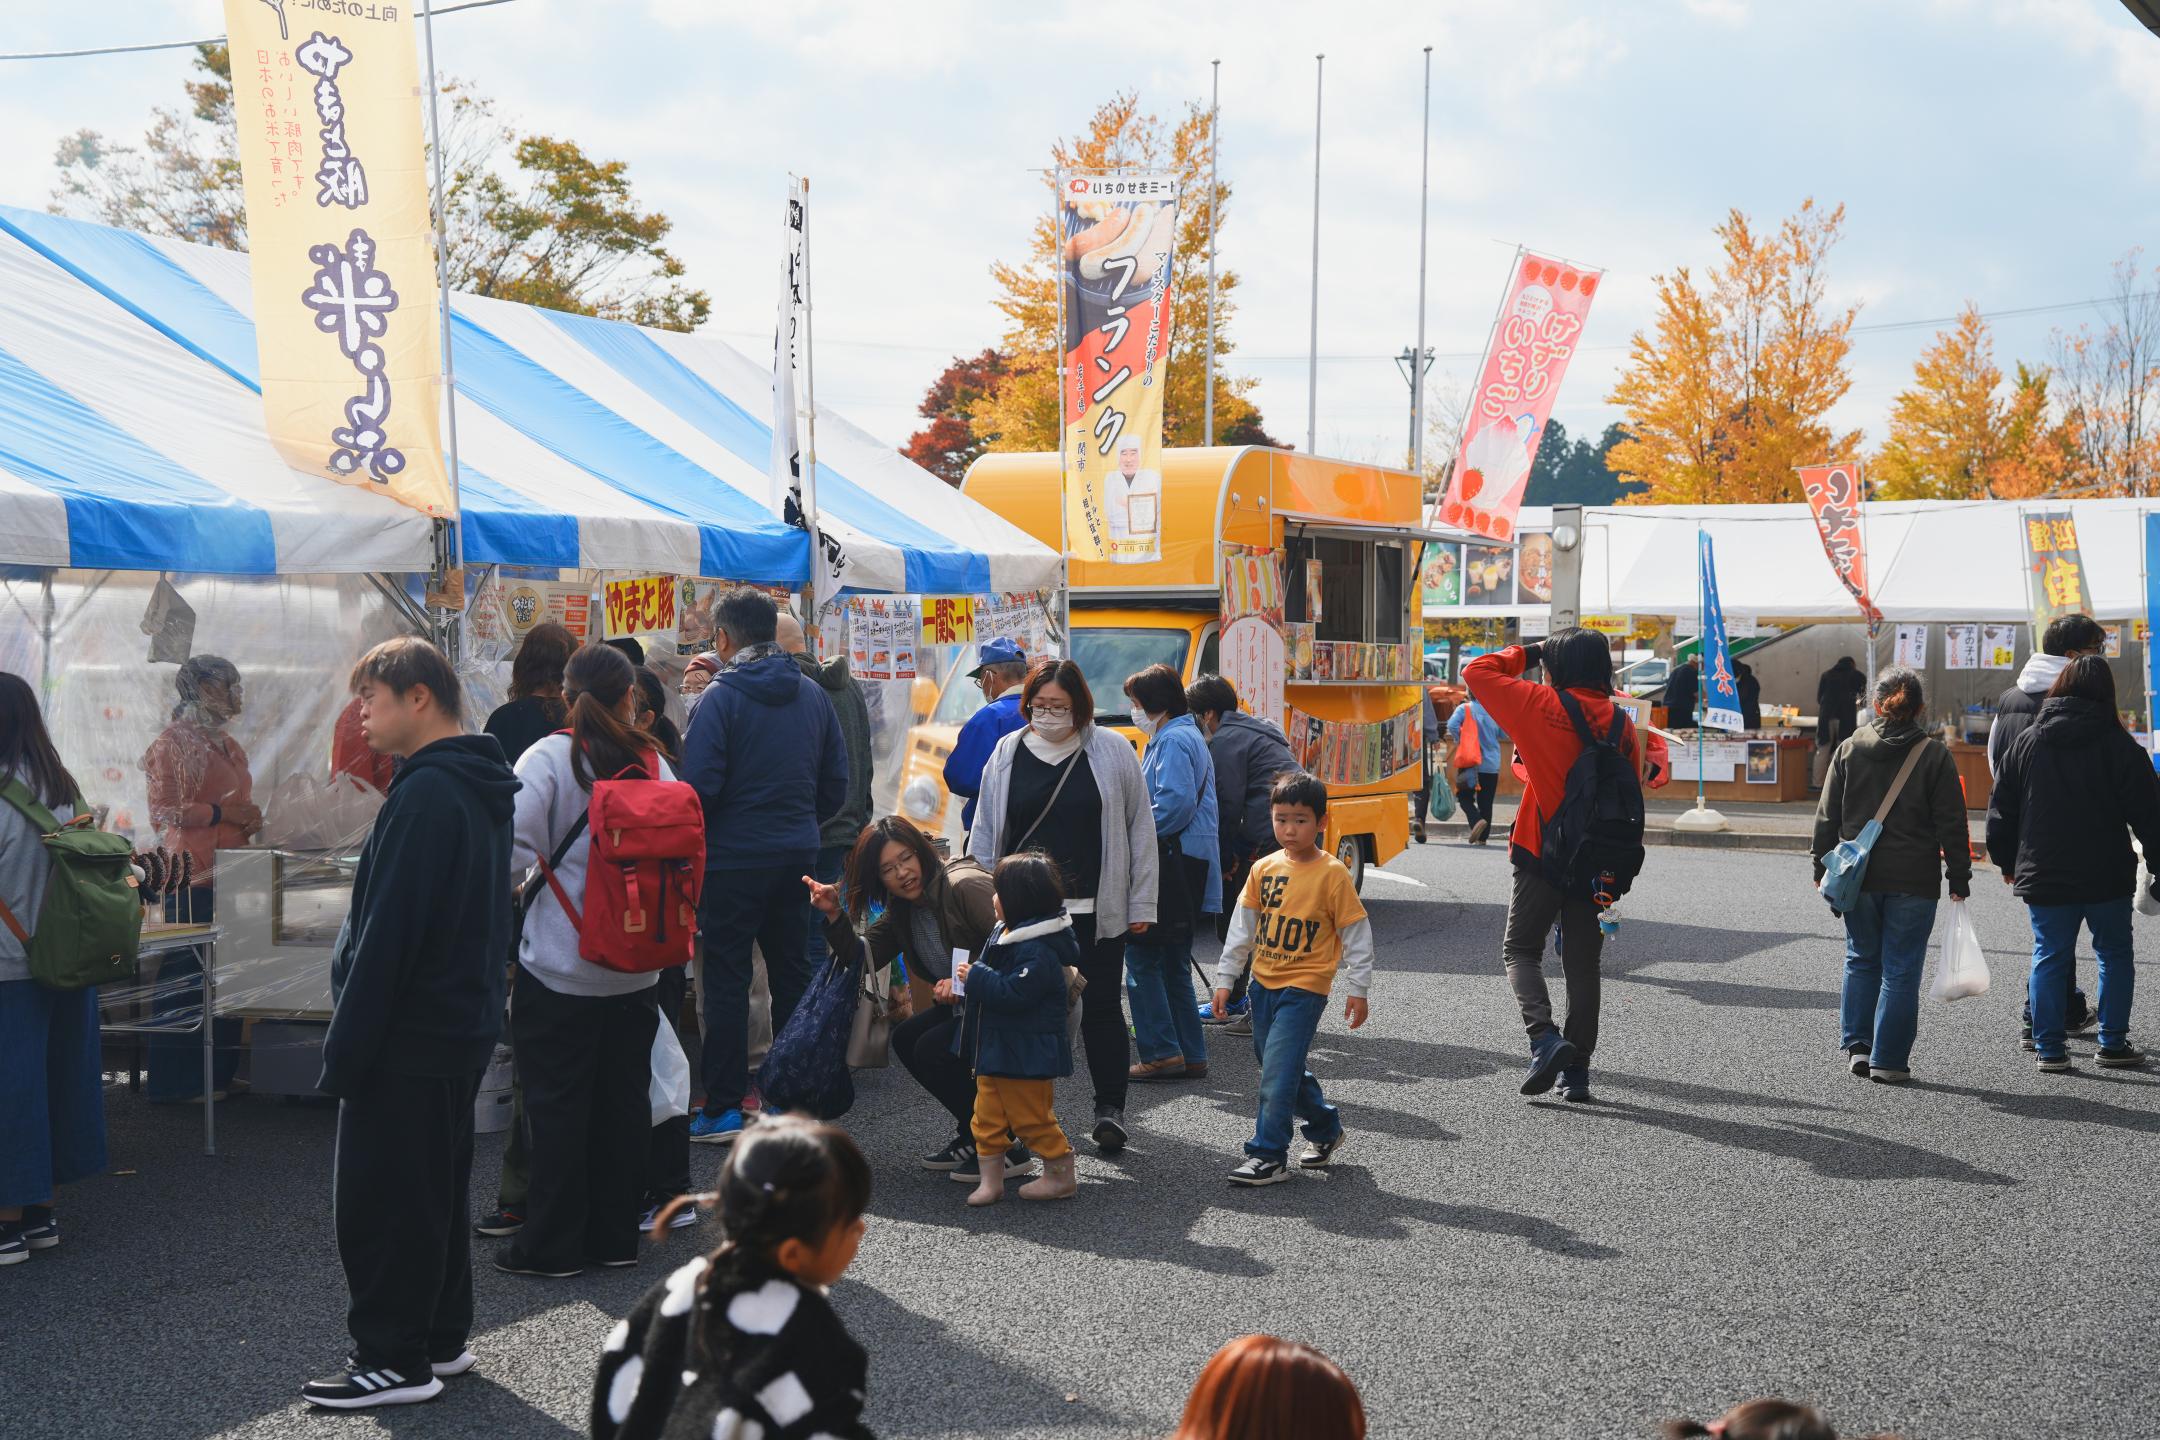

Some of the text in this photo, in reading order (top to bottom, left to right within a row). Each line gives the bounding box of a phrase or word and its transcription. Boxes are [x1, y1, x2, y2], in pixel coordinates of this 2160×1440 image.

[1092, 181, 1175, 196] いちのせきミート
[1092, 255, 1138, 456] フランク
[1142, 250, 1168, 388] マイスターこだわりの
[1482, 315, 1537, 417] いちご
[1522, 312, 1581, 401] けずり
[605, 576, 675, 635] やまと豚
[1260, 875, 1289, 908] BE
[1254, 912, 1320, 953] NJOY
